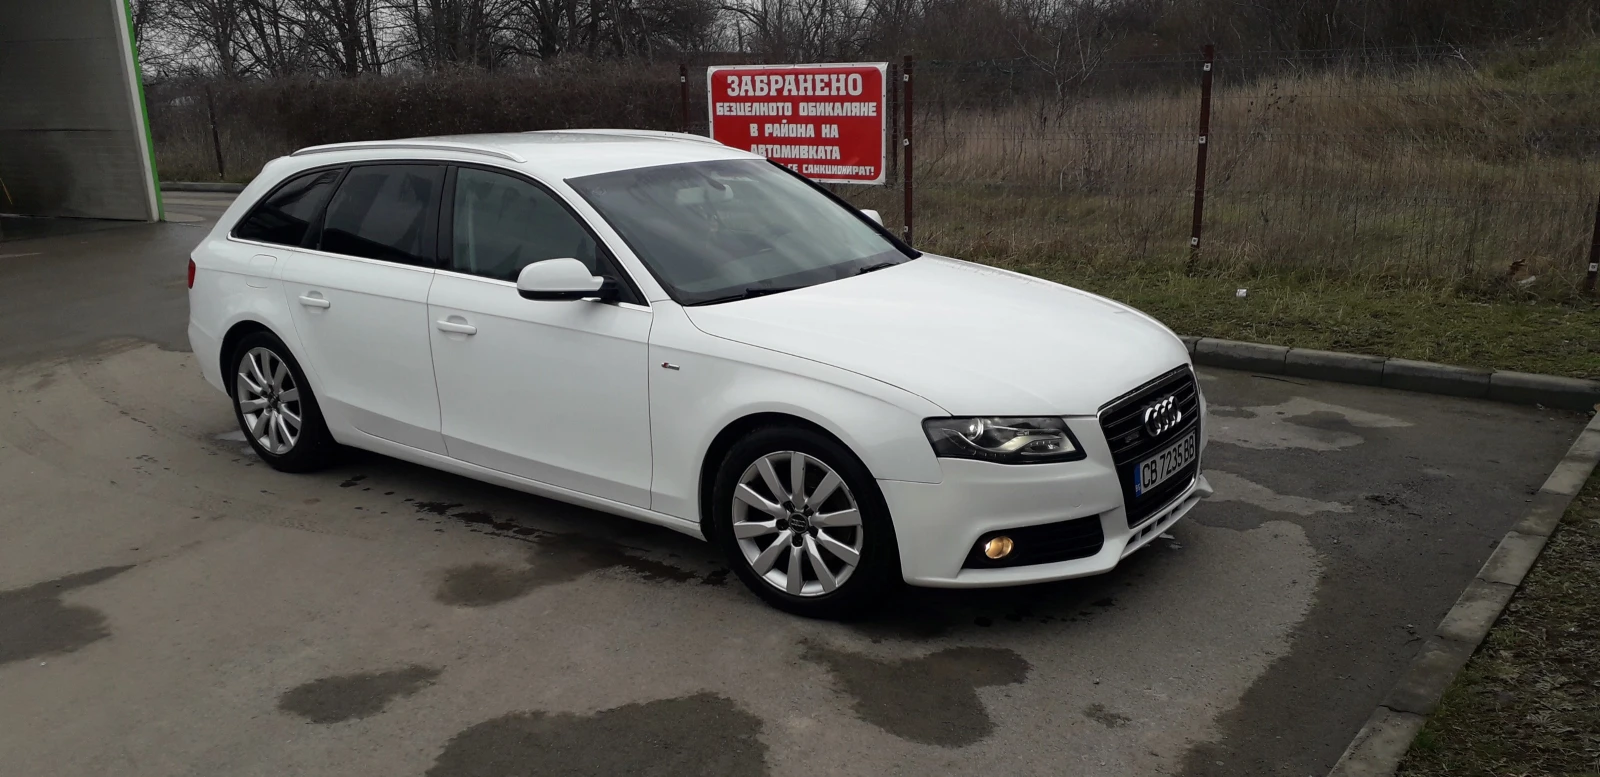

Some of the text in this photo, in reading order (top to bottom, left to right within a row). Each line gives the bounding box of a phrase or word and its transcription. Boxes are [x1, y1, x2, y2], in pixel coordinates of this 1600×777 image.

[727, 73, 863, 97] ЗАБРАНЕНО
[715, 102, 877, 117] БЕЗЦЕЛНОТО ОБИКАЛЯНЕ
[750, 119, 839, 138] В РАЙОНА НА
[750, 144, 841, 160] АВТОМИВКАТА
[1142, 435, 1194, 489] CB 7235 BB
